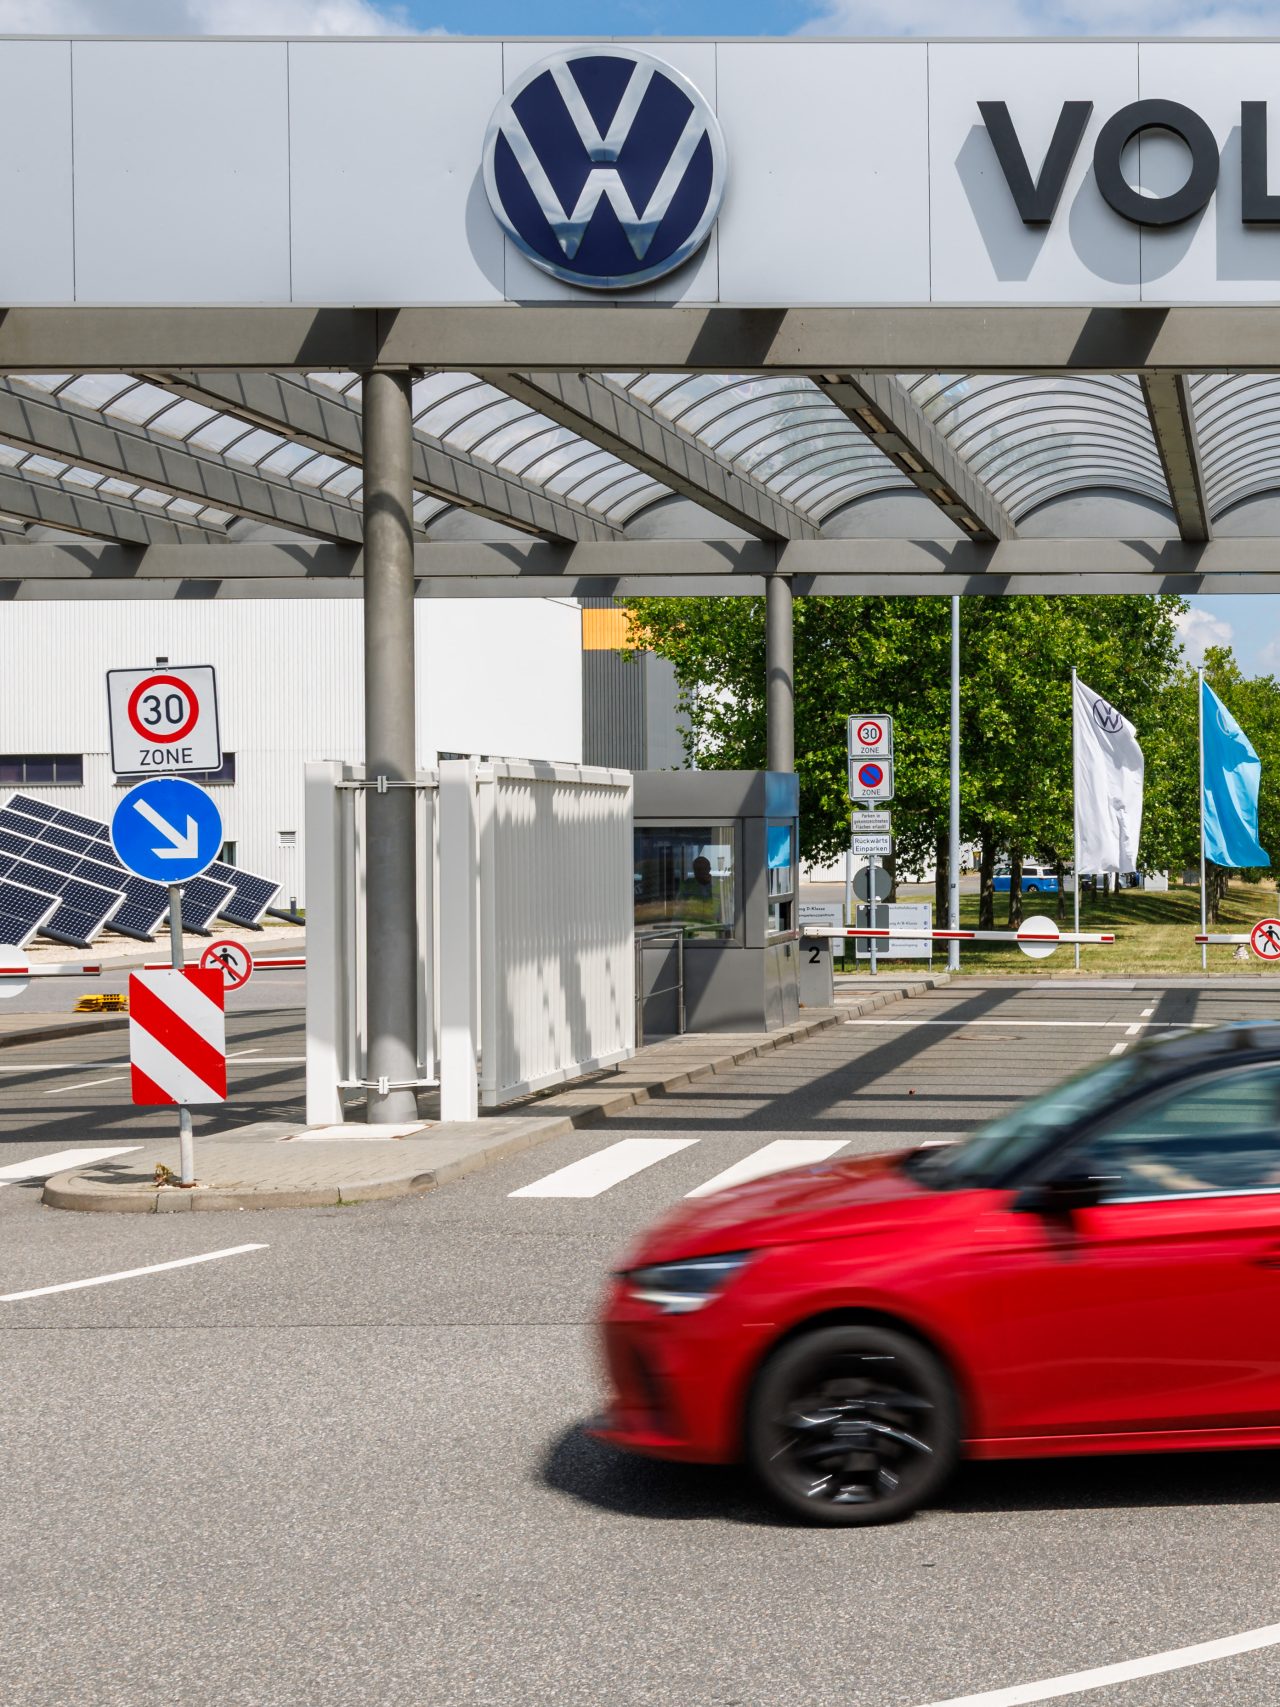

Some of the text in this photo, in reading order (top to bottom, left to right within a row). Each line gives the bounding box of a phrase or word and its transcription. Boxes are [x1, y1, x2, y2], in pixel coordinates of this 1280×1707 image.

[143, 694, 184, 725] 30
[862, 727, 877, 740] 30
[140, 748, 193, 766] ZONE
[860, 746, 880, 754] ZONE
[808, 946, 821, 964] 2
